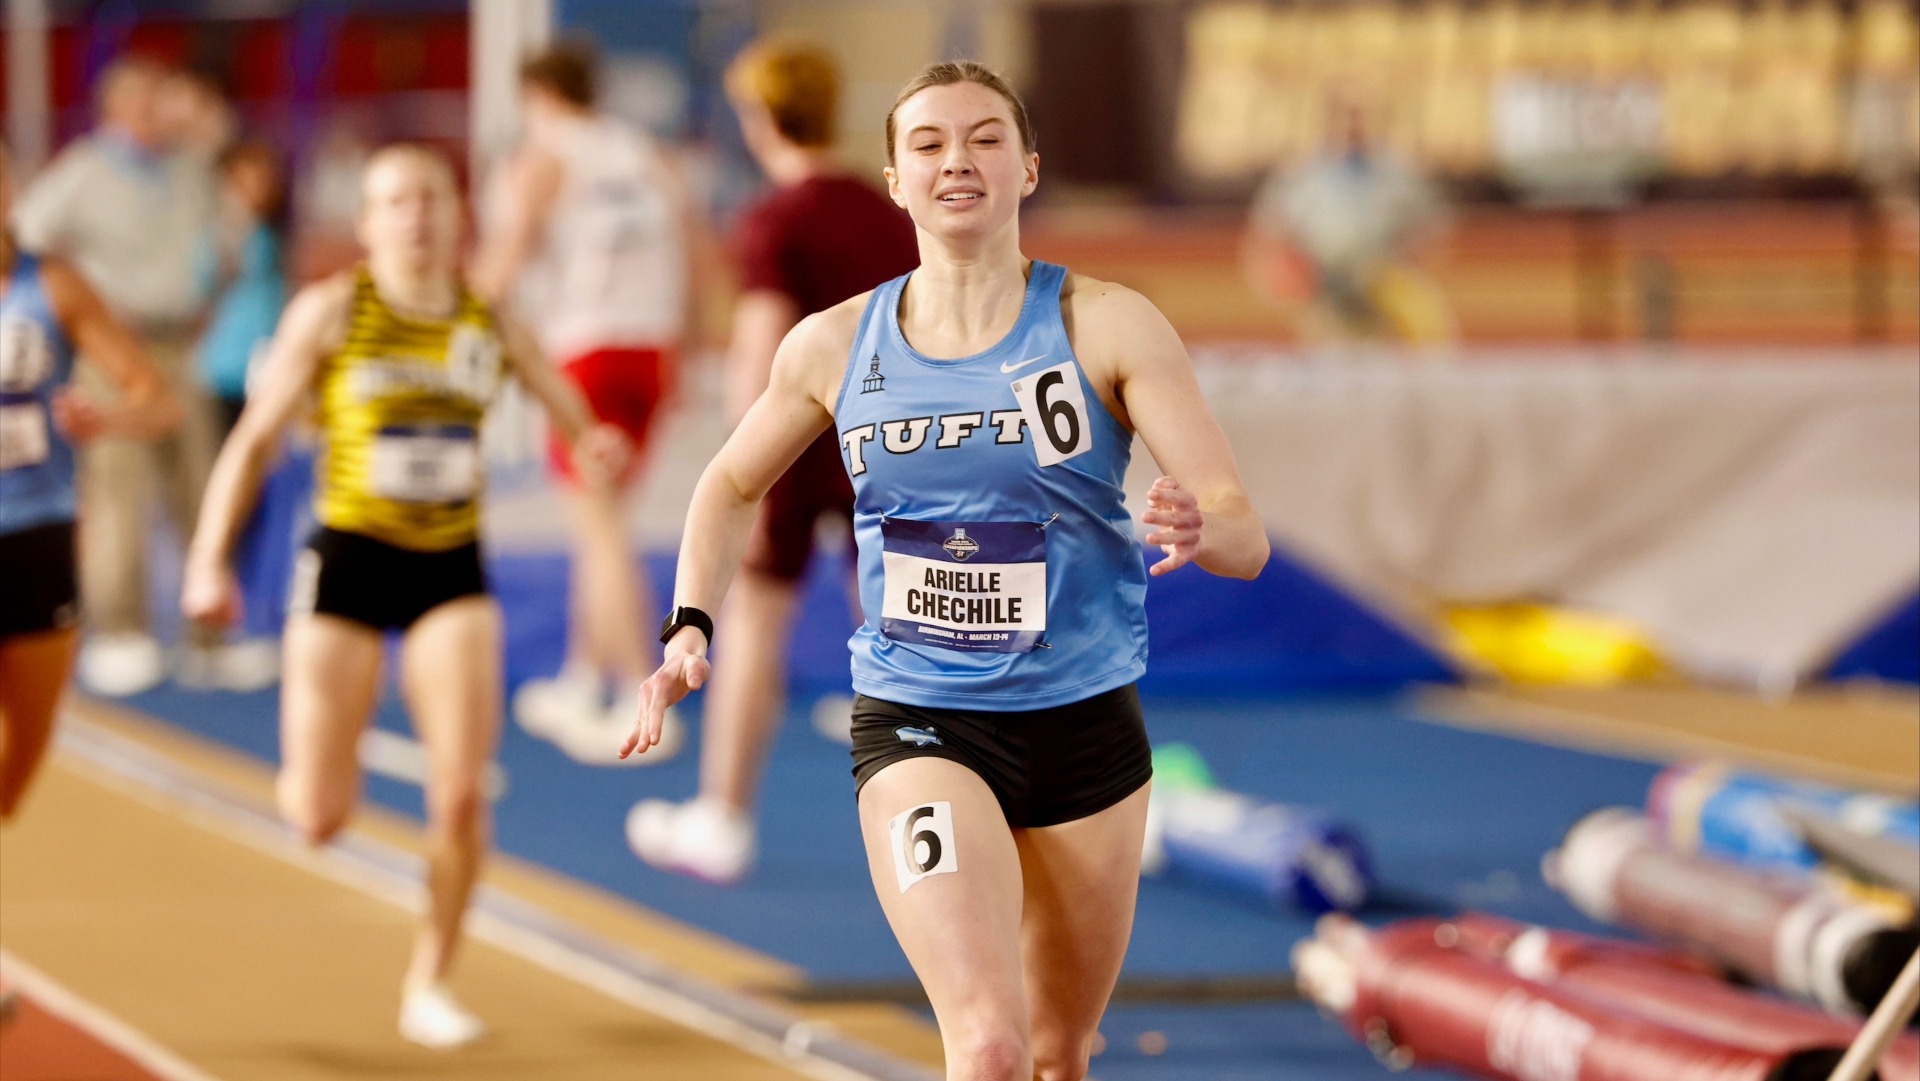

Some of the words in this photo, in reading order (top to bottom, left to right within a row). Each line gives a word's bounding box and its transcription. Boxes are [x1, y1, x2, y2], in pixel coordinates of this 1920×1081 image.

[1035, 370, 1080, 454] 6
[842, 409, 1032, 477] TUFT
[907, 588, 1022, 624] CHECHILE
[924, 567, 1001, 593] ARIELLE
[969, 633, 992, 641] MARCH
[903, 806, 942, 875] 6
